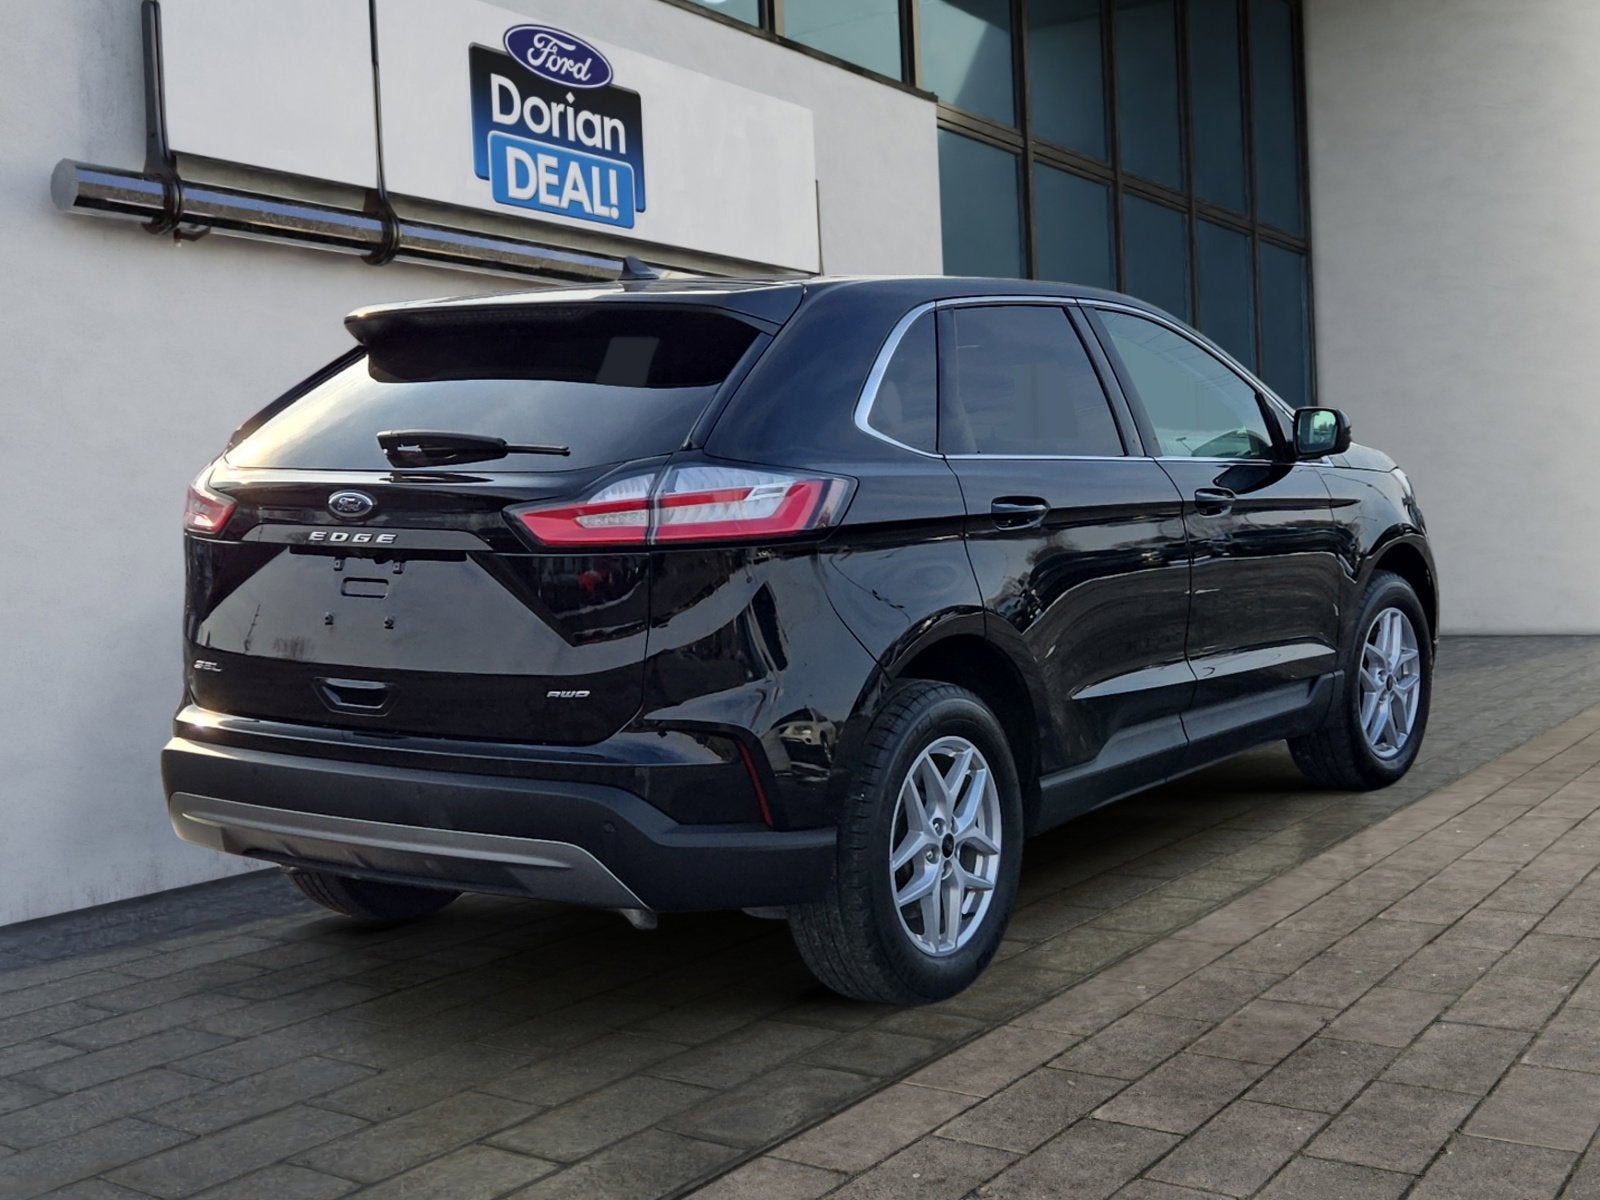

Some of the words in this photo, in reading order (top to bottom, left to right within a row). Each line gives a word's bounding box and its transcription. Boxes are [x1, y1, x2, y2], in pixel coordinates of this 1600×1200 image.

[527, 33, 592, 81] Ford
[490, 73, 626, 154] Dorian
[506, 146, 620, 220] DEAL!
[337, 496, 361, 512] Ford
[308, 531, 398, 544] EDGE
[546, 690, 590, 698] AWD
